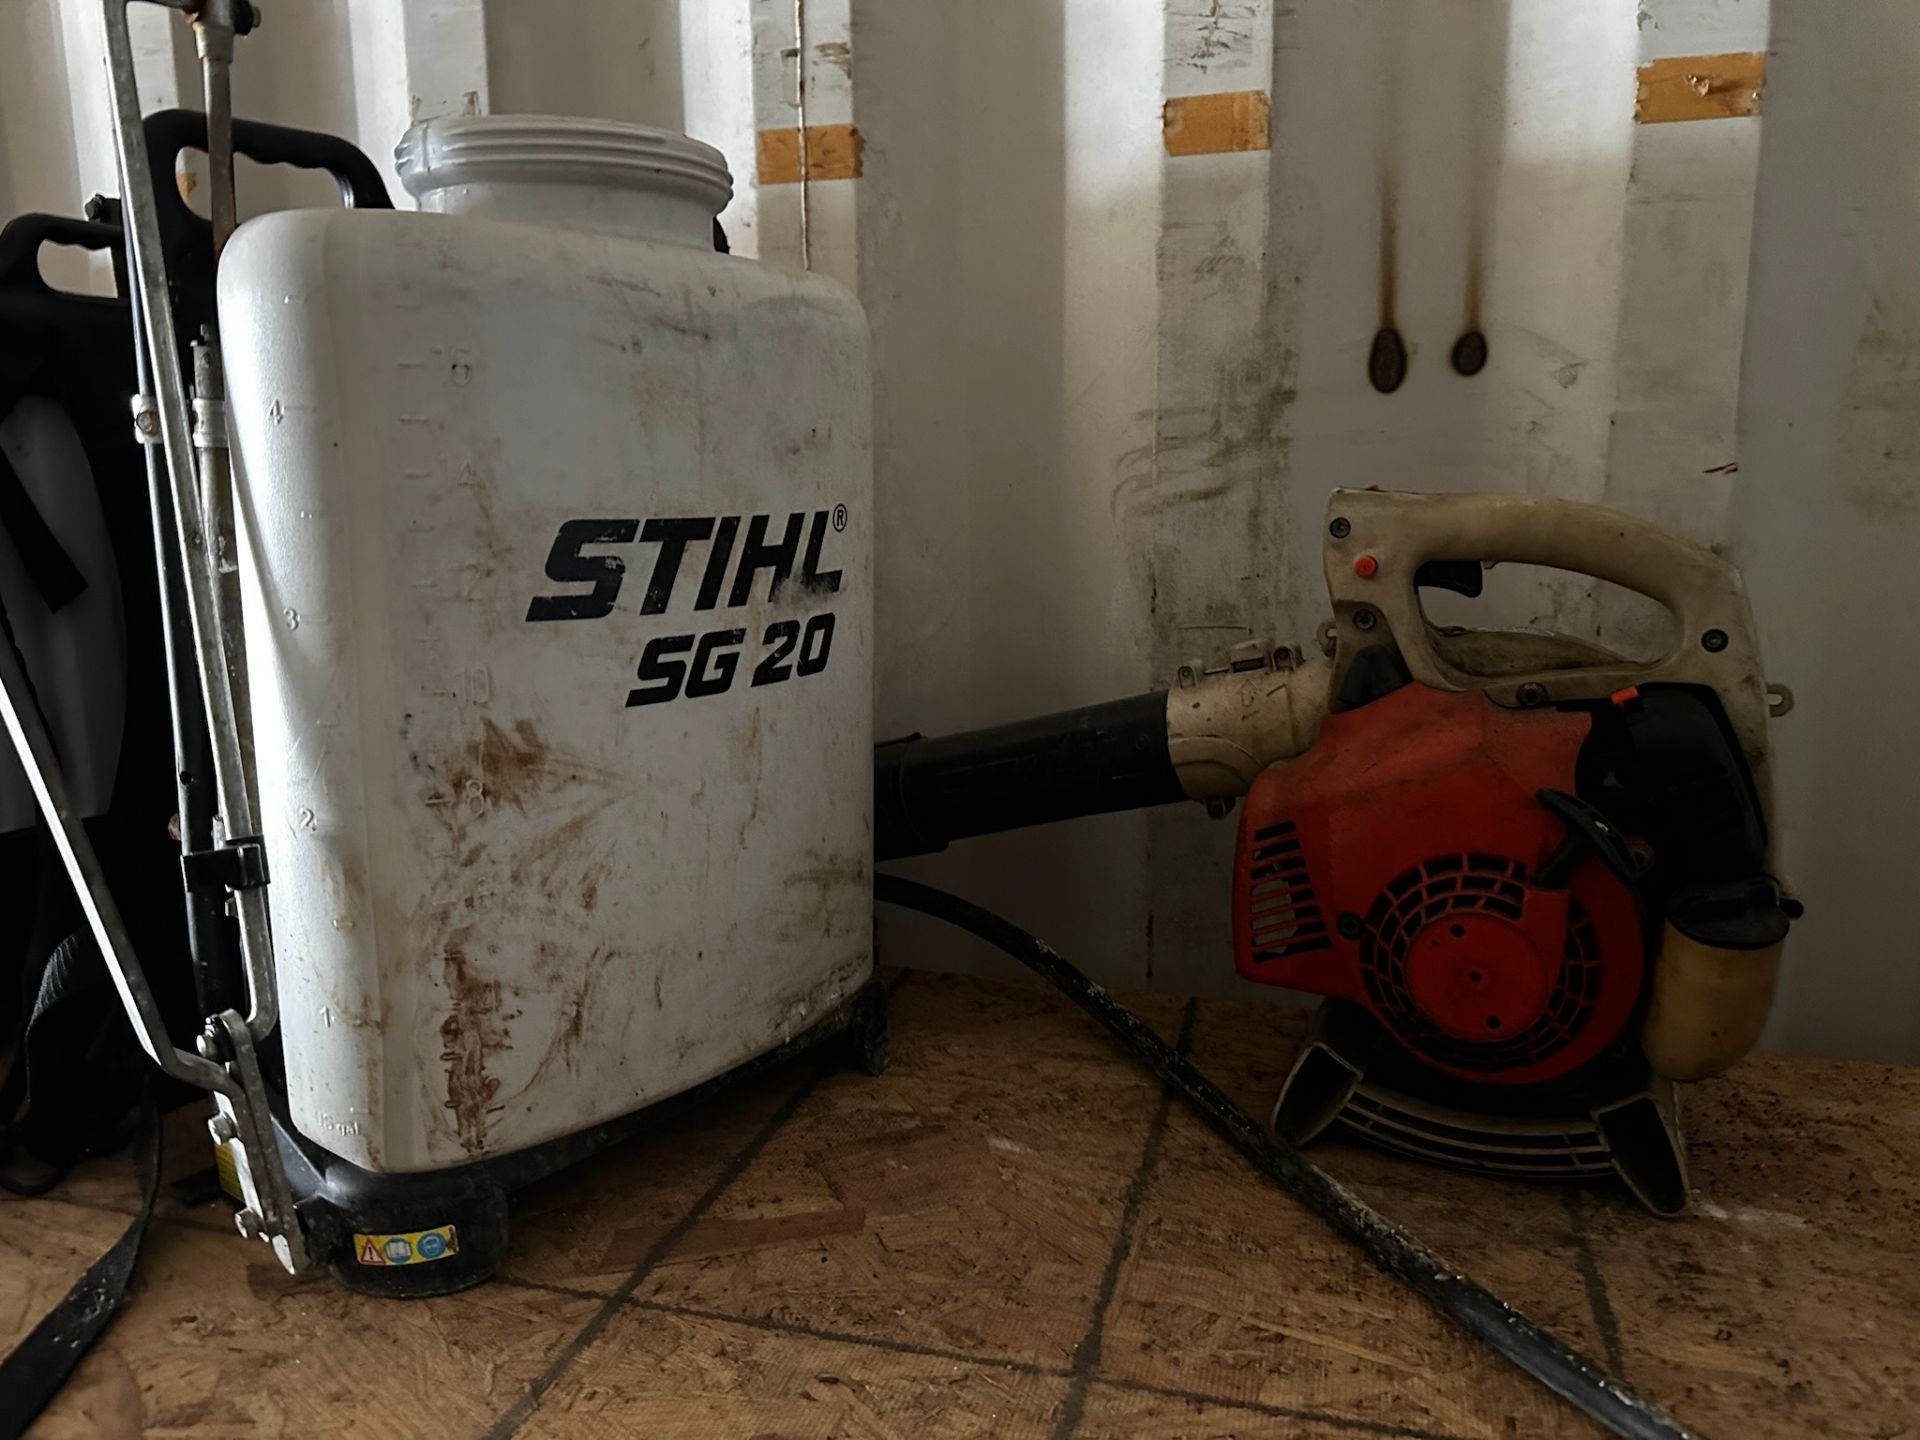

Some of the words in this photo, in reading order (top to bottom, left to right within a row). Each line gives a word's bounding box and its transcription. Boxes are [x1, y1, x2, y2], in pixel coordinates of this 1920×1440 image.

[525, 510, 843, 622] STIHL
[283, 607, 299, 632] 3
[625, 628, 747, 708] SG
[751, 612, 836, 688] 20
